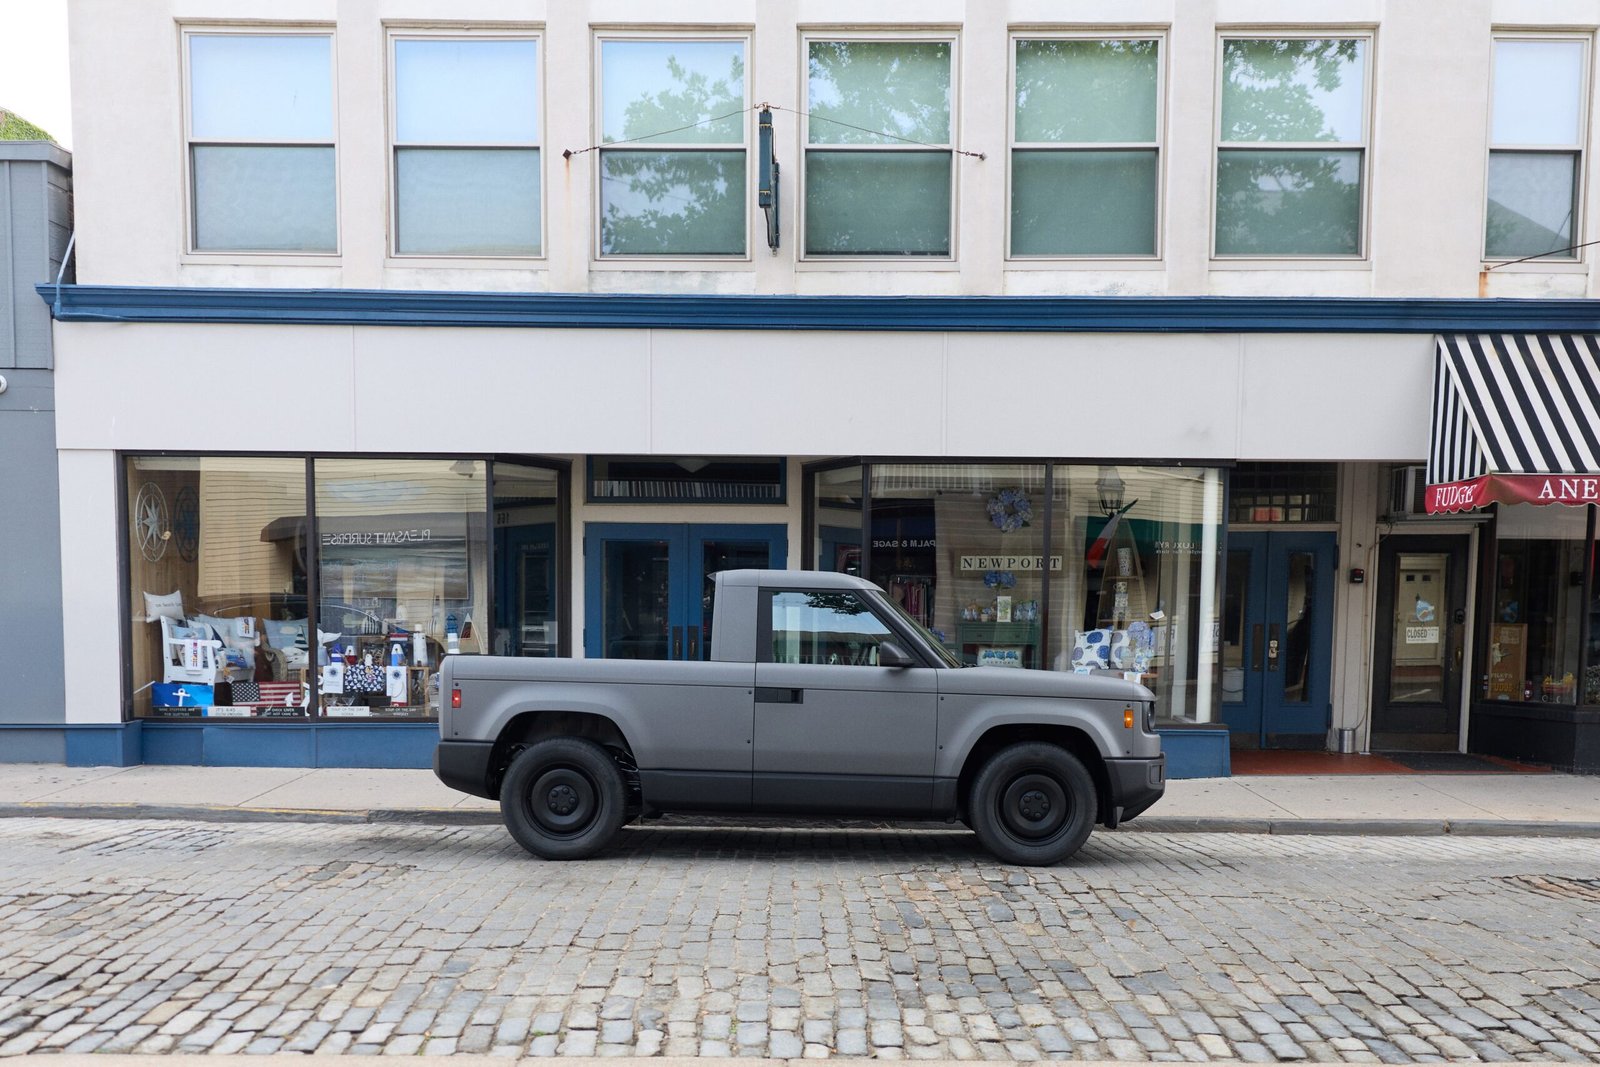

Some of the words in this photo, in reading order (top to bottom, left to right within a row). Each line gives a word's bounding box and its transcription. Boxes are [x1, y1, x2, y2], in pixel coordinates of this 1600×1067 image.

[1435, 484, 1477, 507] FUDGE
[1538, 479, 1599, 499] ANE
[961, 557, 1061, 569] NEWPORT
[1407, 629, 1428, 639] CLOSED
